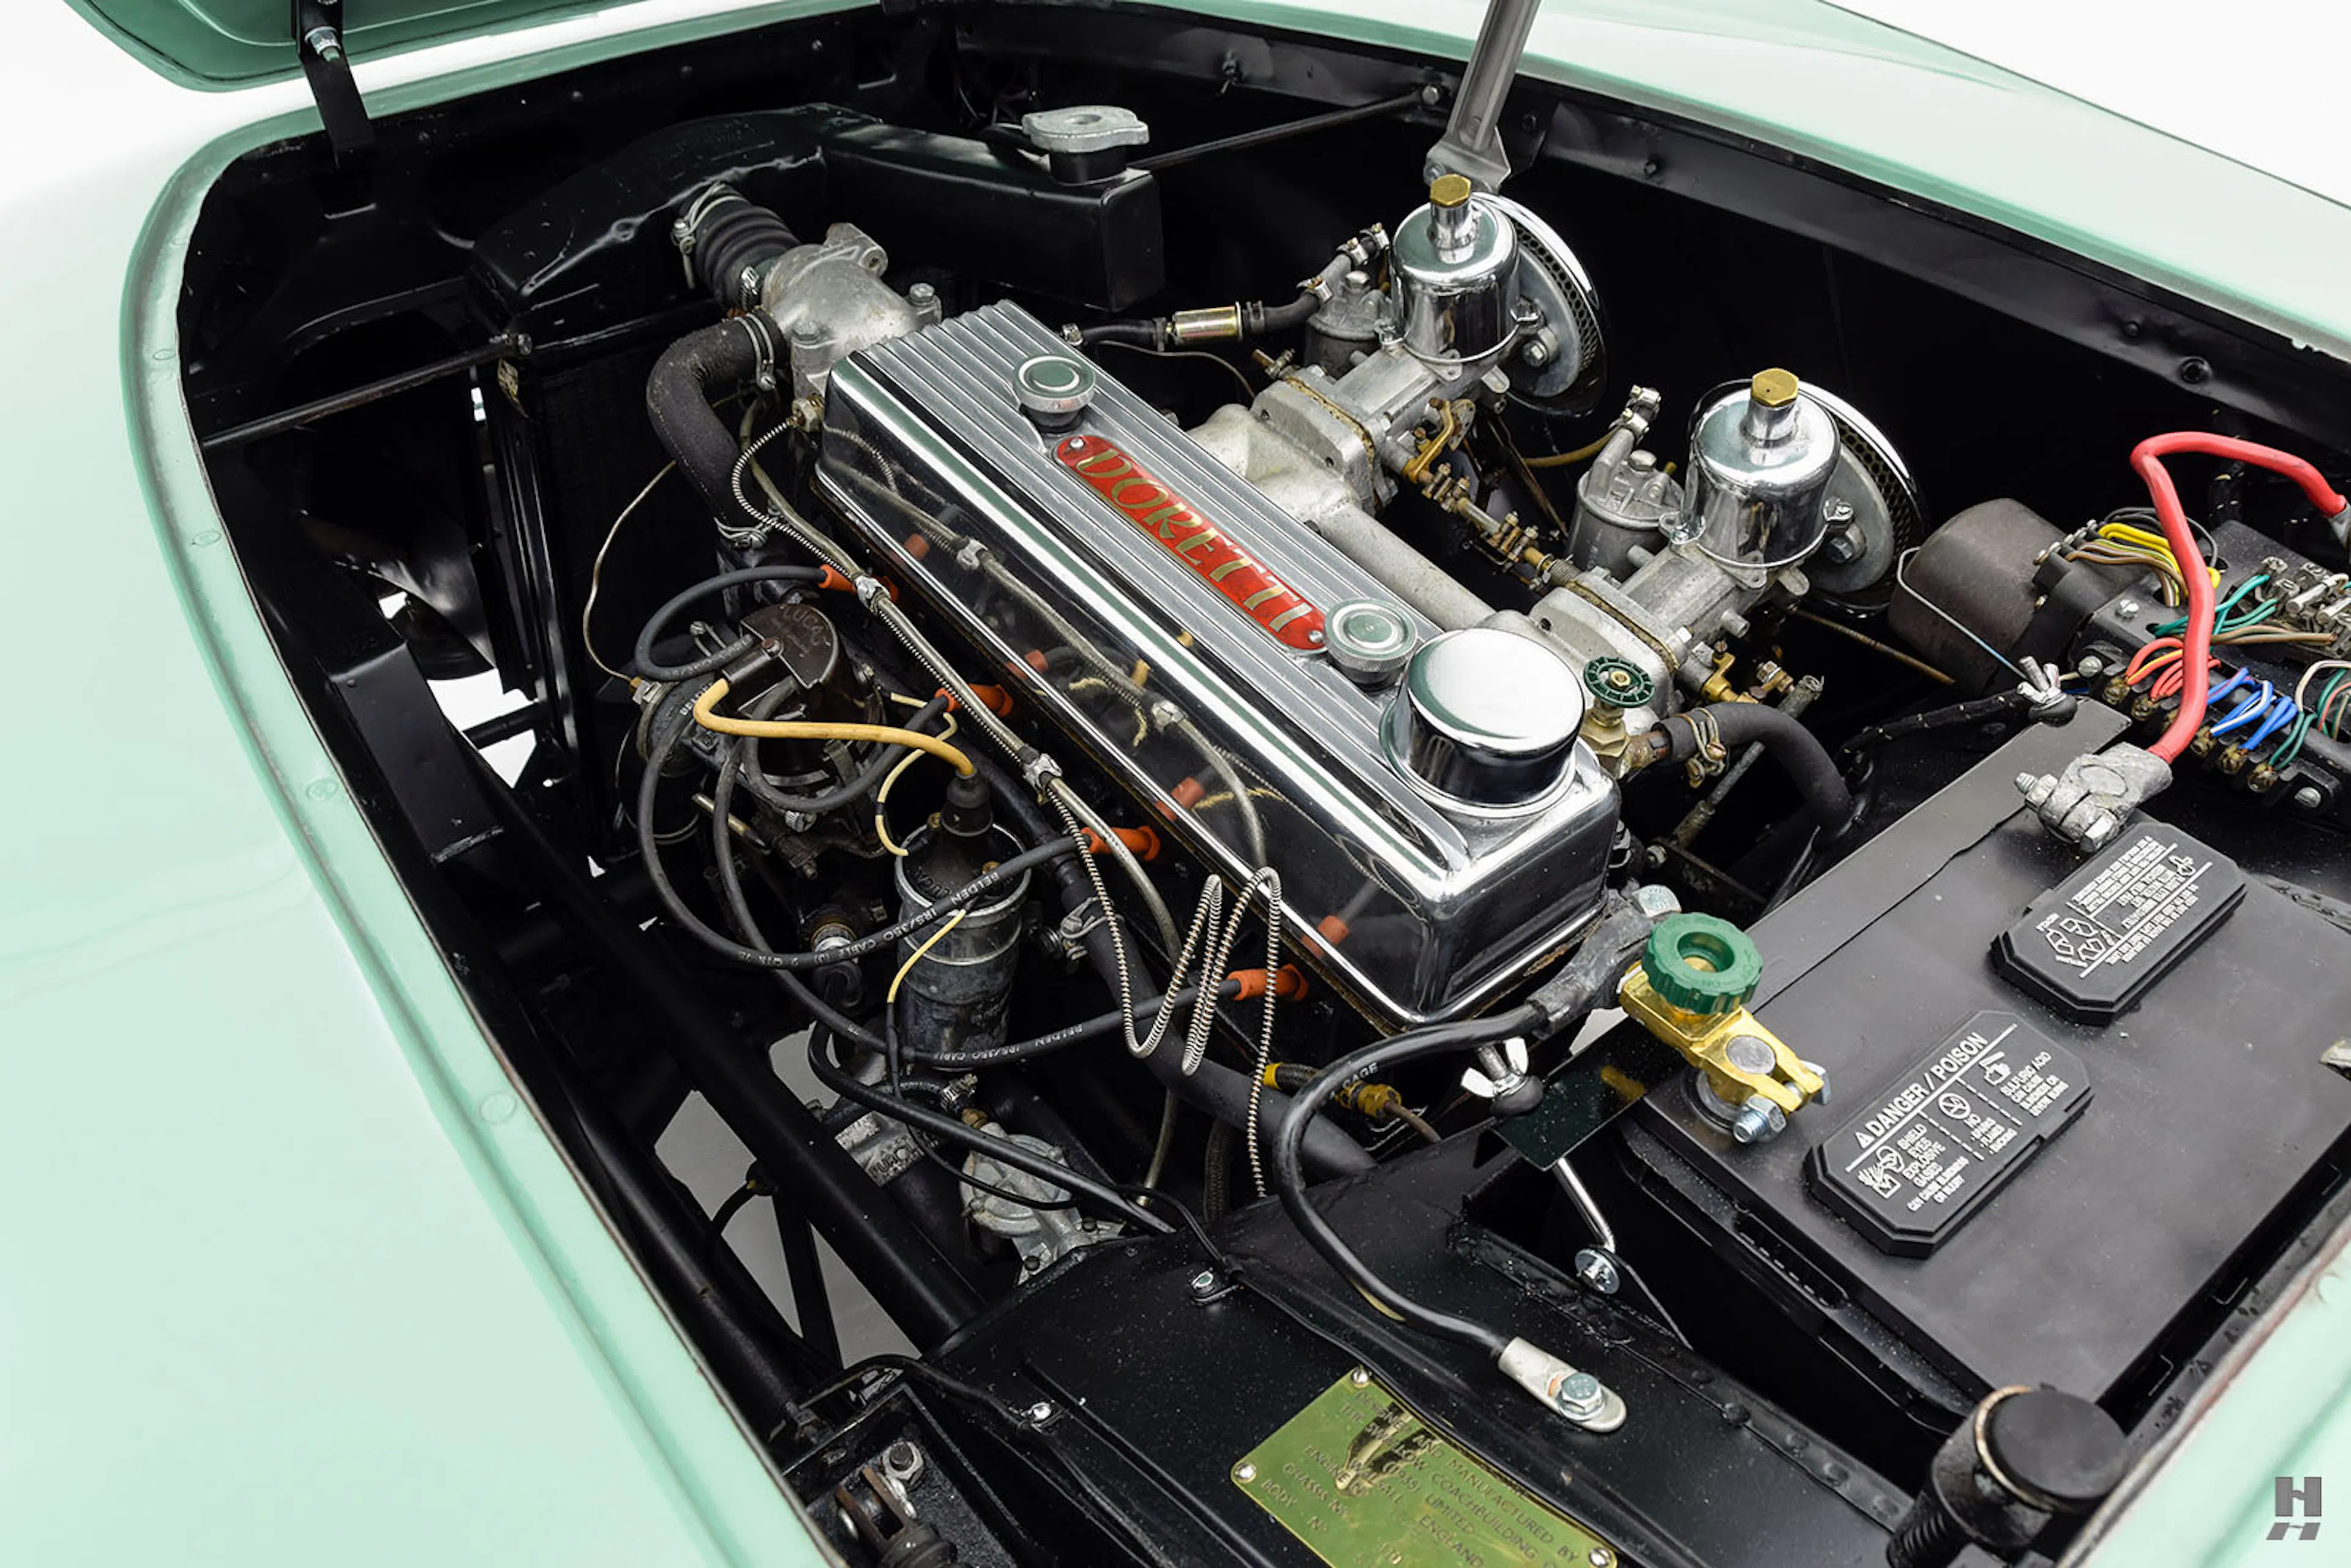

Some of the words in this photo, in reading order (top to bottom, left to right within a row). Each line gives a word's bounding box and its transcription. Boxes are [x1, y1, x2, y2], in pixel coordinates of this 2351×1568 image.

[1076, 449, 1312, 634] DORETTI
[951, 872, 1000, 906] BELDEN
[838, 939, 877, 958] CABLE
[1866, 1083, 1930, 1138] DANGER
[1924, 1073, 1935, 1090] /
[1932, 1032, 1989, 1082] POISON
[1897, 1124, 1927, 1149] SHIELD
[1907, 1137, 1932, 1158] EYES
[1902, 1141, 1946, 1179] EXPLOSIVE
[1302, 1442, 1352, 1485] ENGINE
[1259, 1477, 1298, 1510] BODY
[1363, 1420, 1428, 1474] SWALLOW
[1429, 1471, 1539, 1561] COACHBUILDING
[1413, 1431, 1445, 1461] AND
[1445, 1456, 1554, 1546] MANUFACTURED
[1556, 1544, 1578, 1566] BY
[1423, 1490, 1477, 1537] LIMITED
[1417, 1514, 1485, 1568] ENGLAND
